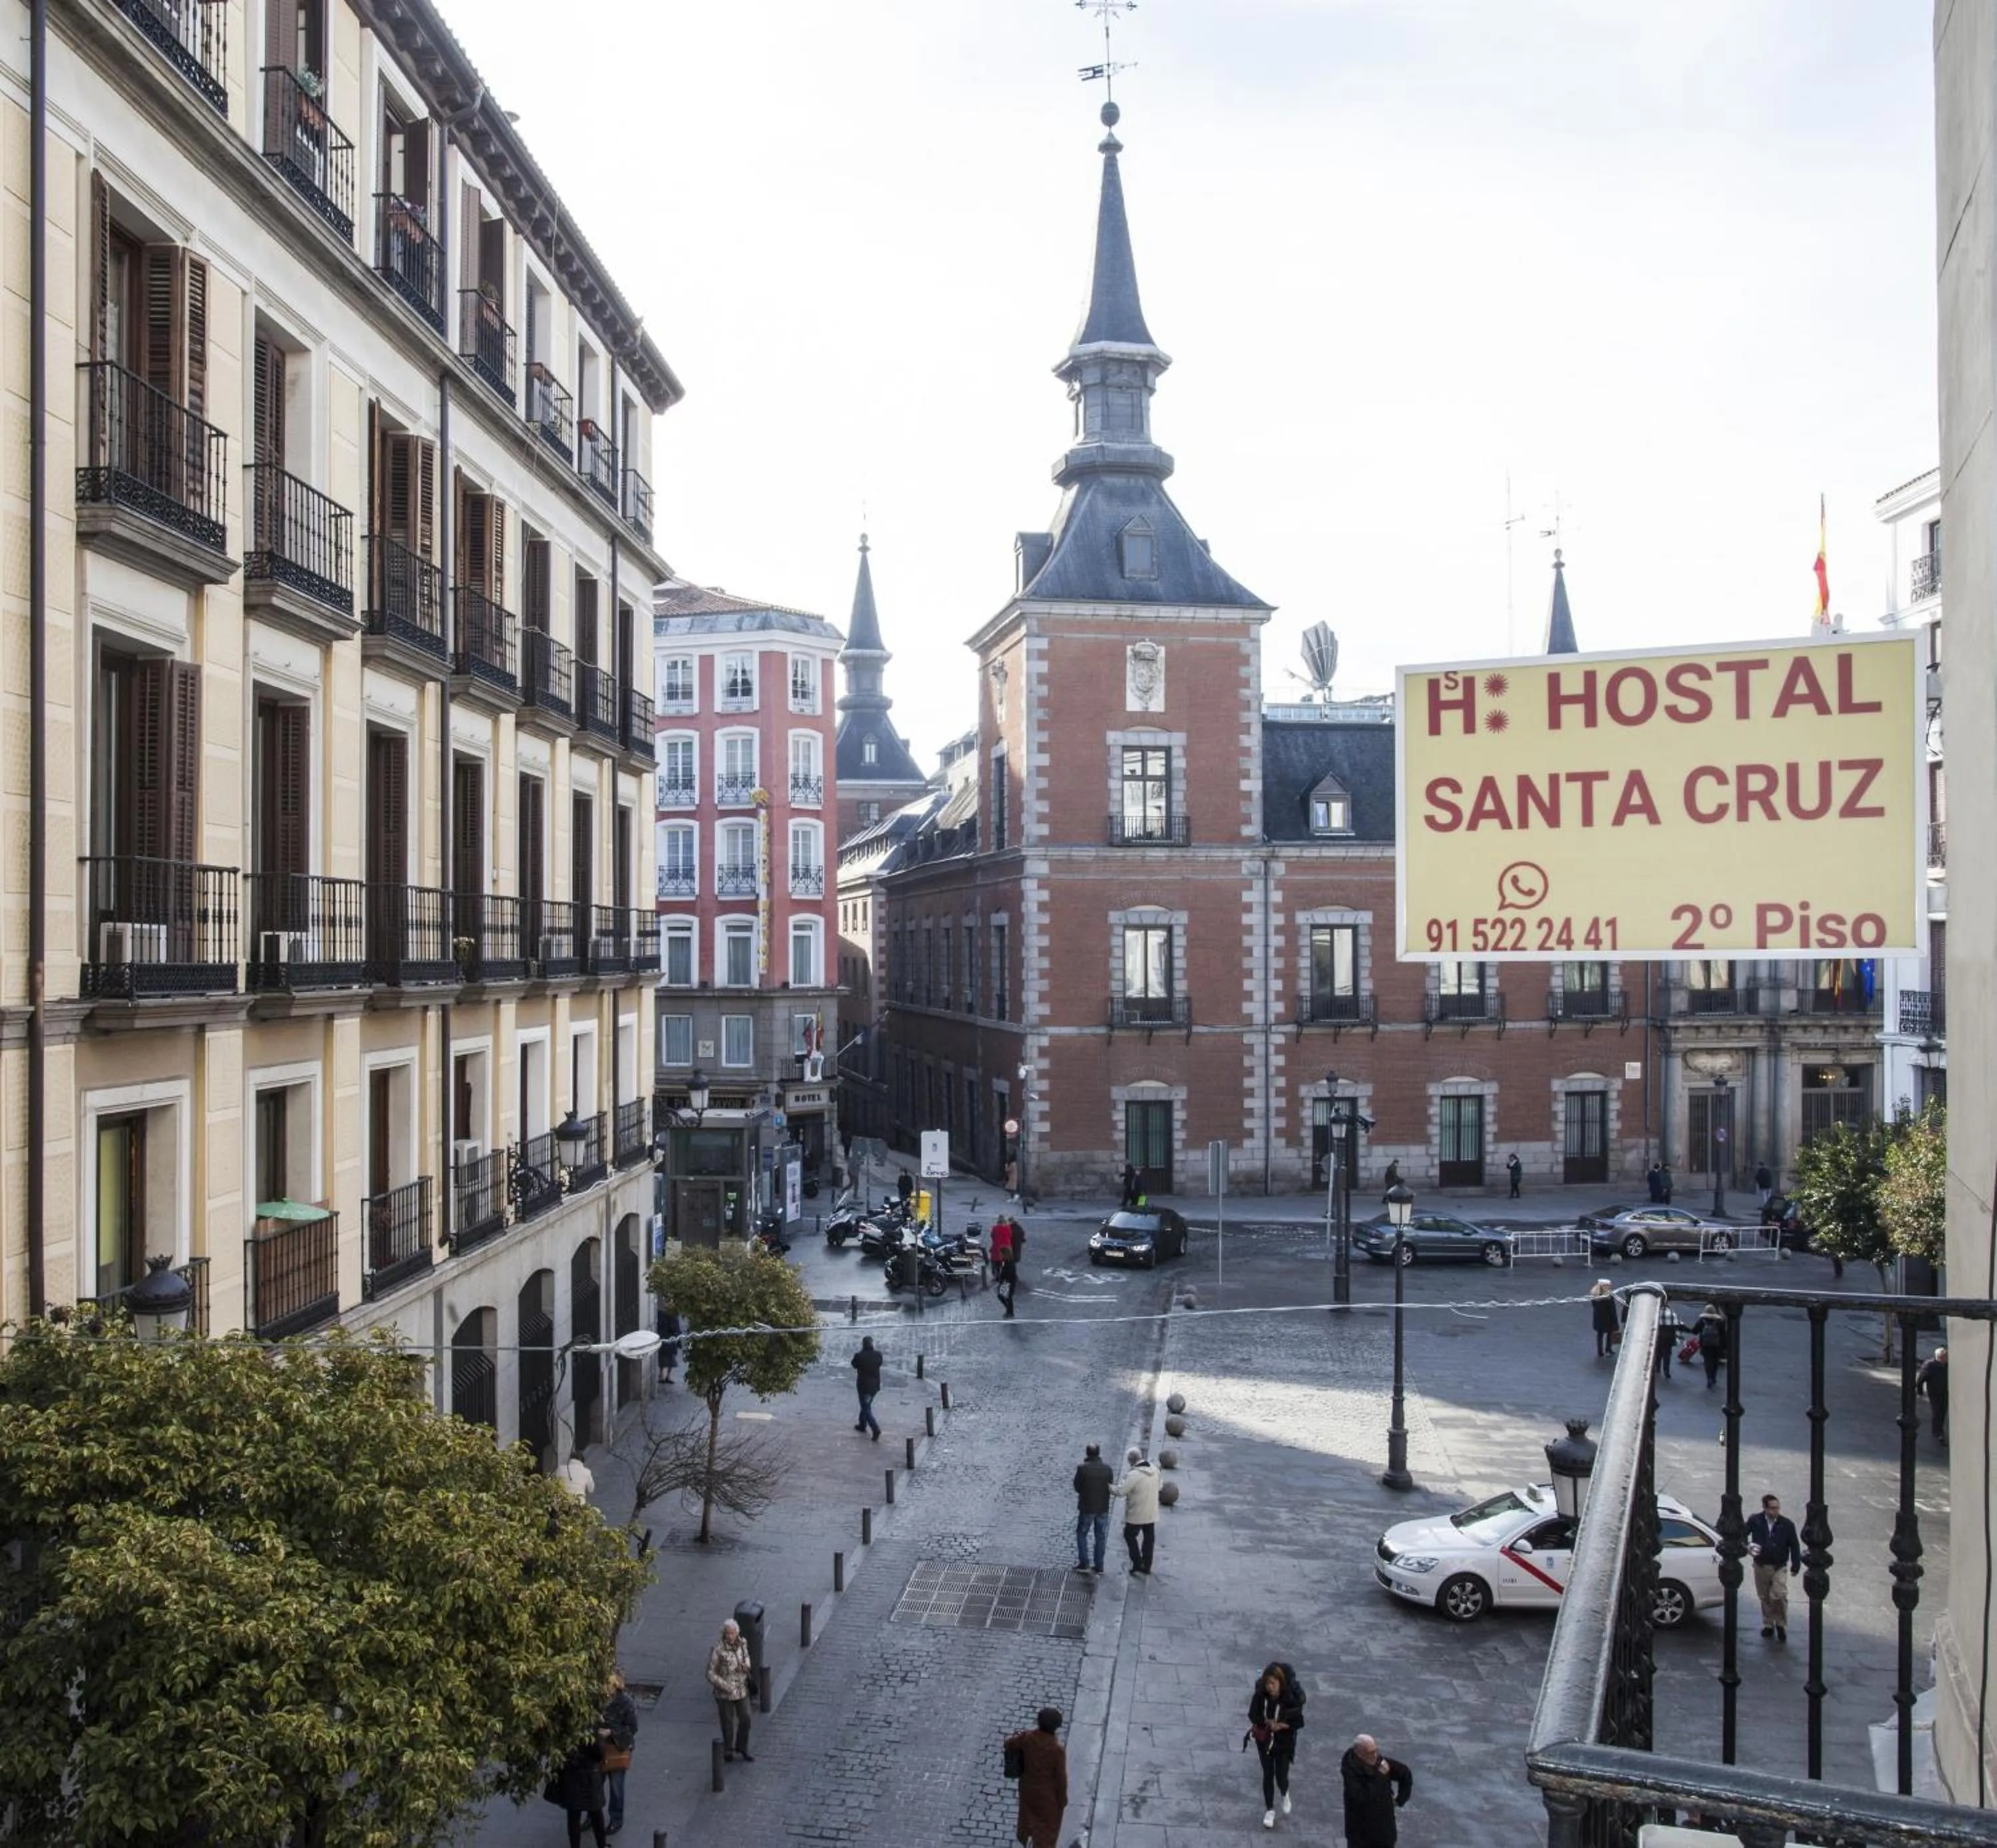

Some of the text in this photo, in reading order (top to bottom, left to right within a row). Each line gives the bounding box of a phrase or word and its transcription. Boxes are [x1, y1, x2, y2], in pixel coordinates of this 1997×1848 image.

[1547, 653, 1883, 730] HOSTAL
[1425, 759, 1885, 832] SANTA CRUZ
[1427, 917, 1617, 952] 91 522 24 41
[1756, 901, 1886, 949] Piso
[794, 1094, 821, 1102] HOTEL
